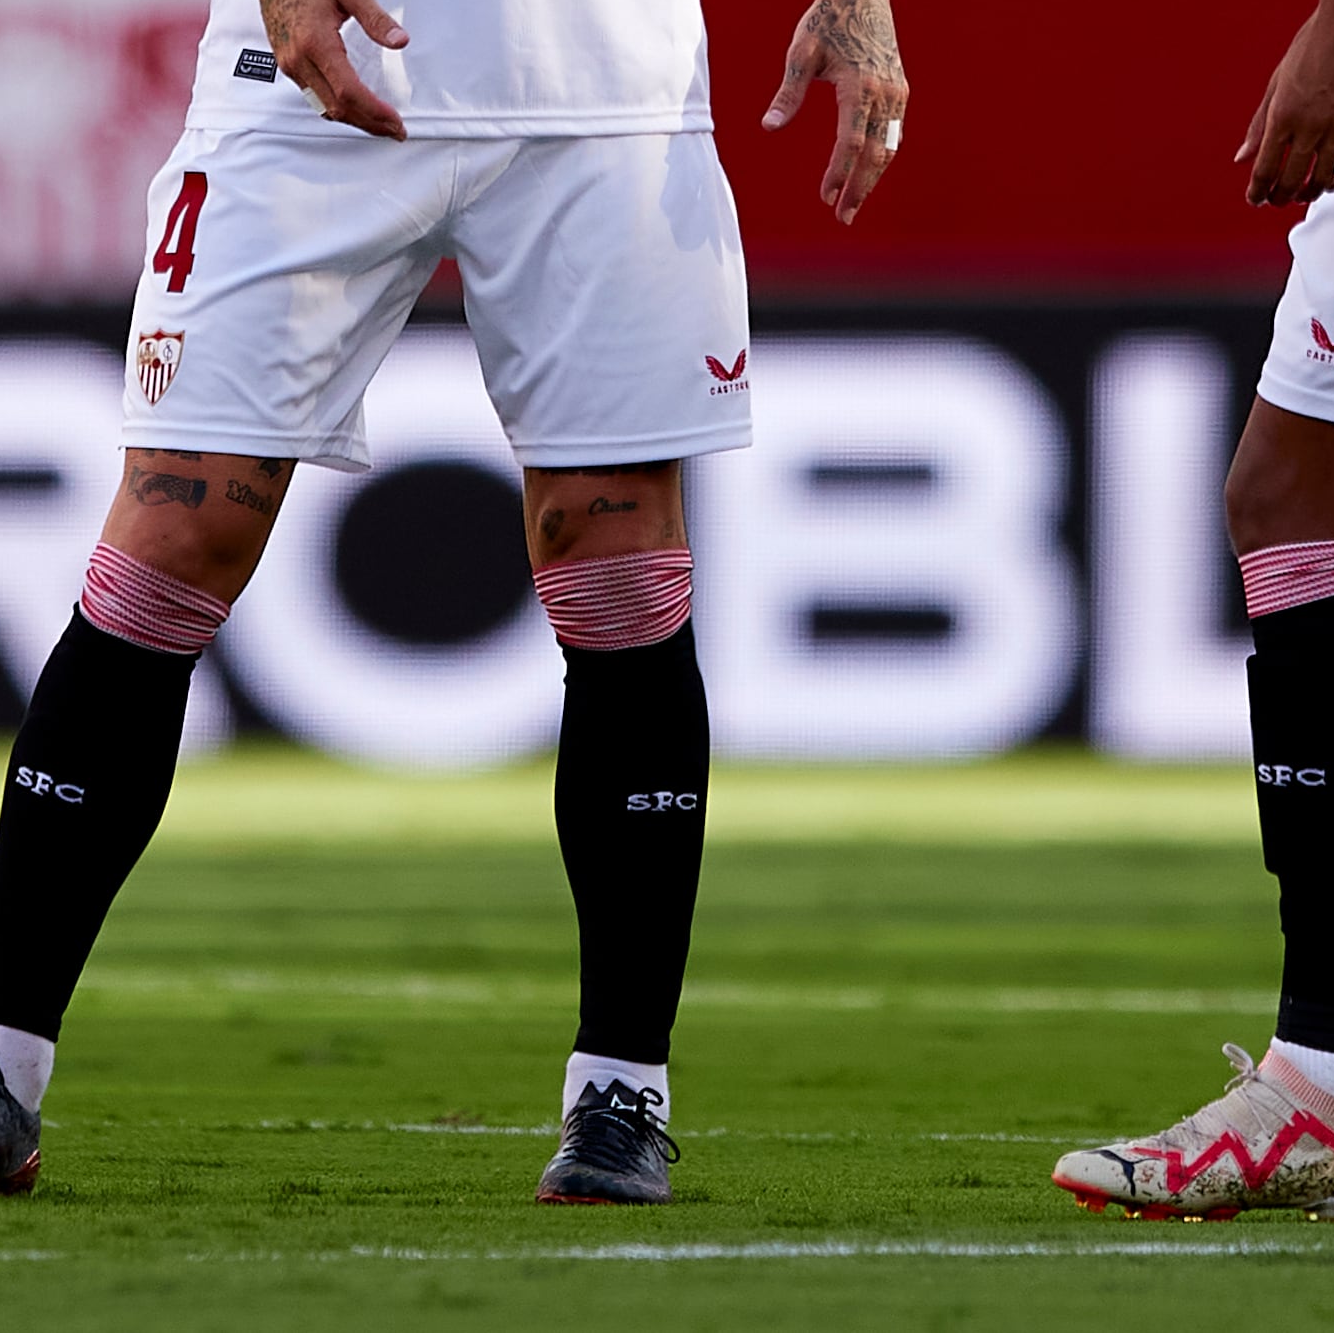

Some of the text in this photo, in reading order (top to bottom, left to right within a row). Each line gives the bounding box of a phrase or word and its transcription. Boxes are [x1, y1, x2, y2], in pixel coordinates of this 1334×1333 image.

[152, 170, 209, 294] 4
[14, 761, 87, 802] SFC
[1255, 762, 1331, 787] SFC
[625, 788, 699, 813] SFC
